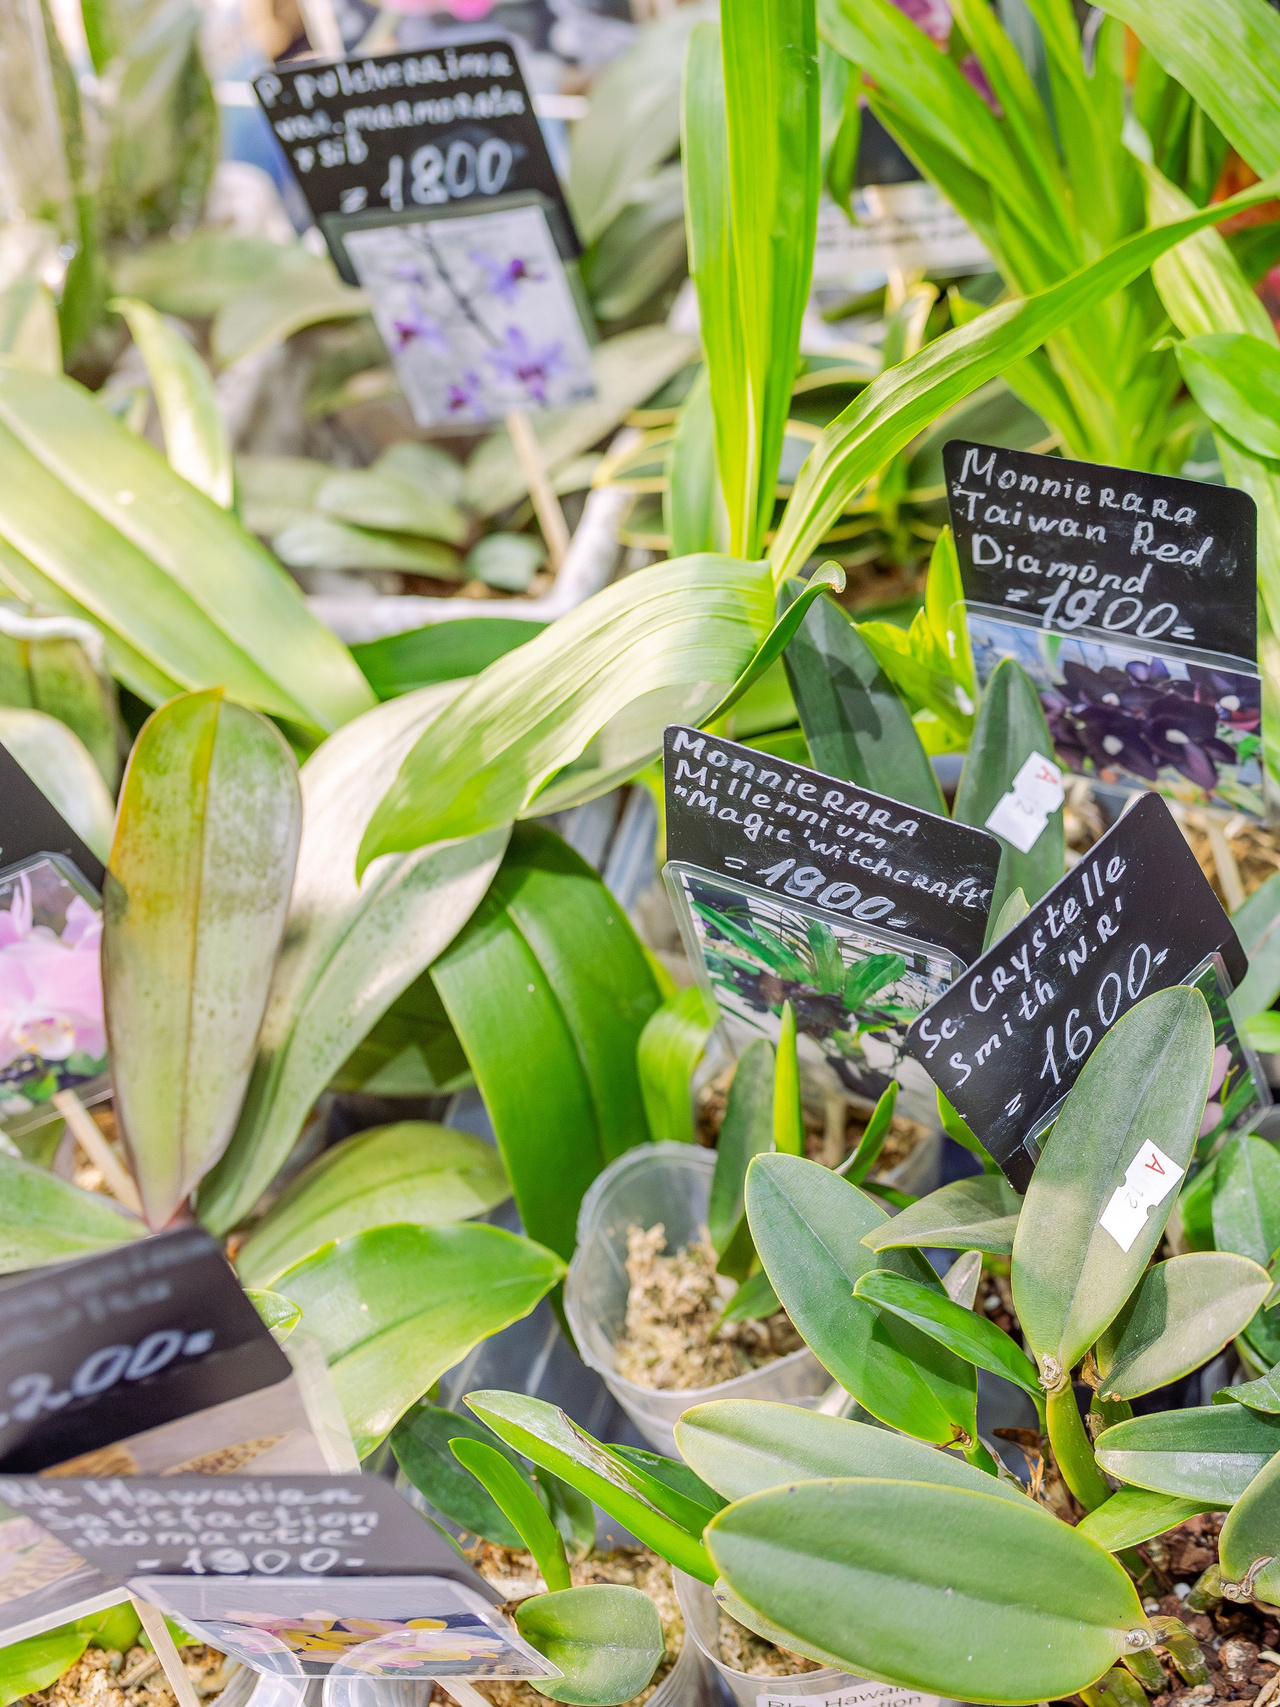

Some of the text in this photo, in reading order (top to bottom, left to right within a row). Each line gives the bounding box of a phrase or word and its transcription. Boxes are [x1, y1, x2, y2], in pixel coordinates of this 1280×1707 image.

[953, 488, 1214, 567] Taiwan Red
[971, 533, 1154, 594] Diamond
[674, 759, 886, 850] Millennium
[949, 980, 1055, 1088] Smith
[1144, 1153, 1166, 1176] A
